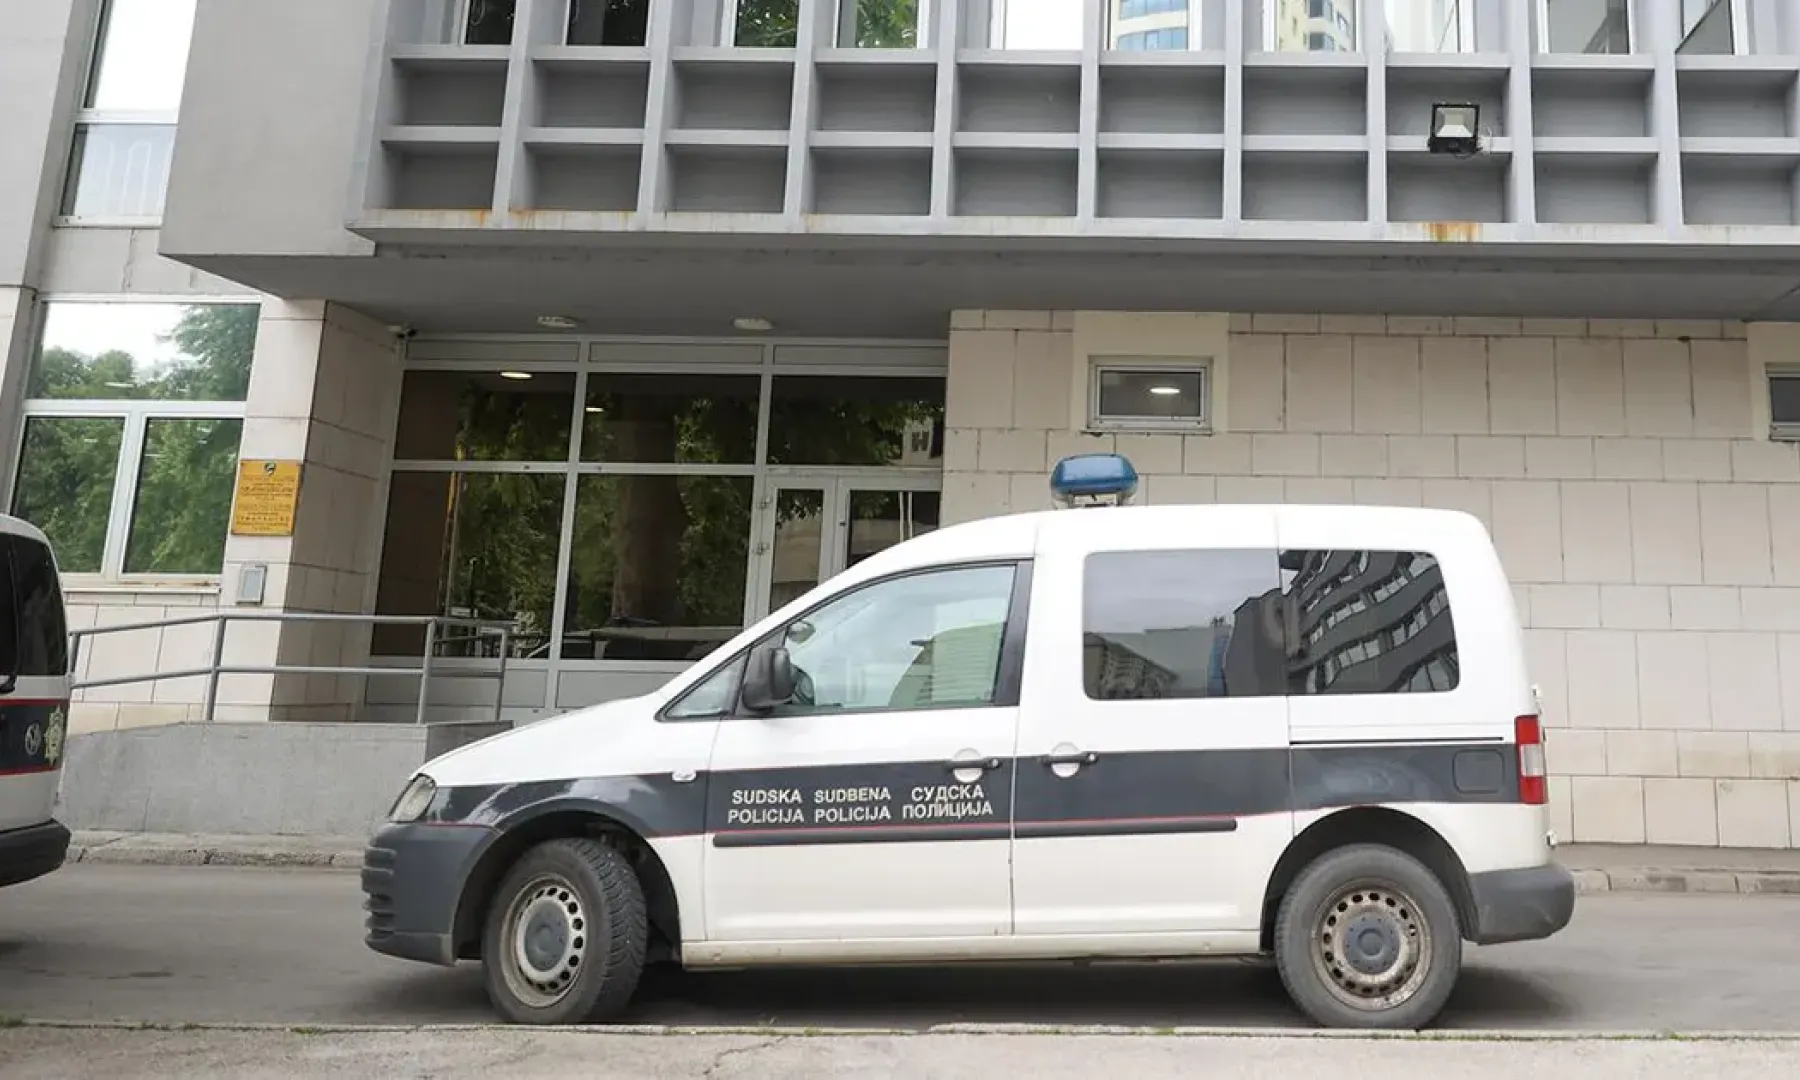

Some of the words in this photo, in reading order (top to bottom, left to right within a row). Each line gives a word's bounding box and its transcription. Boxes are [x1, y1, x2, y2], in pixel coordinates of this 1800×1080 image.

[732, 789, 803, 804] SUDSKA
[814, 787, 892, 803] SUDBENA
[912, 785, 985, 802] СУДСКА
[728, 807, 805, 824] POLICIJA
[815, 805, 892, 822] POLICIJA
[903, 801, 994, 820] ПОЛИЦИЈА
